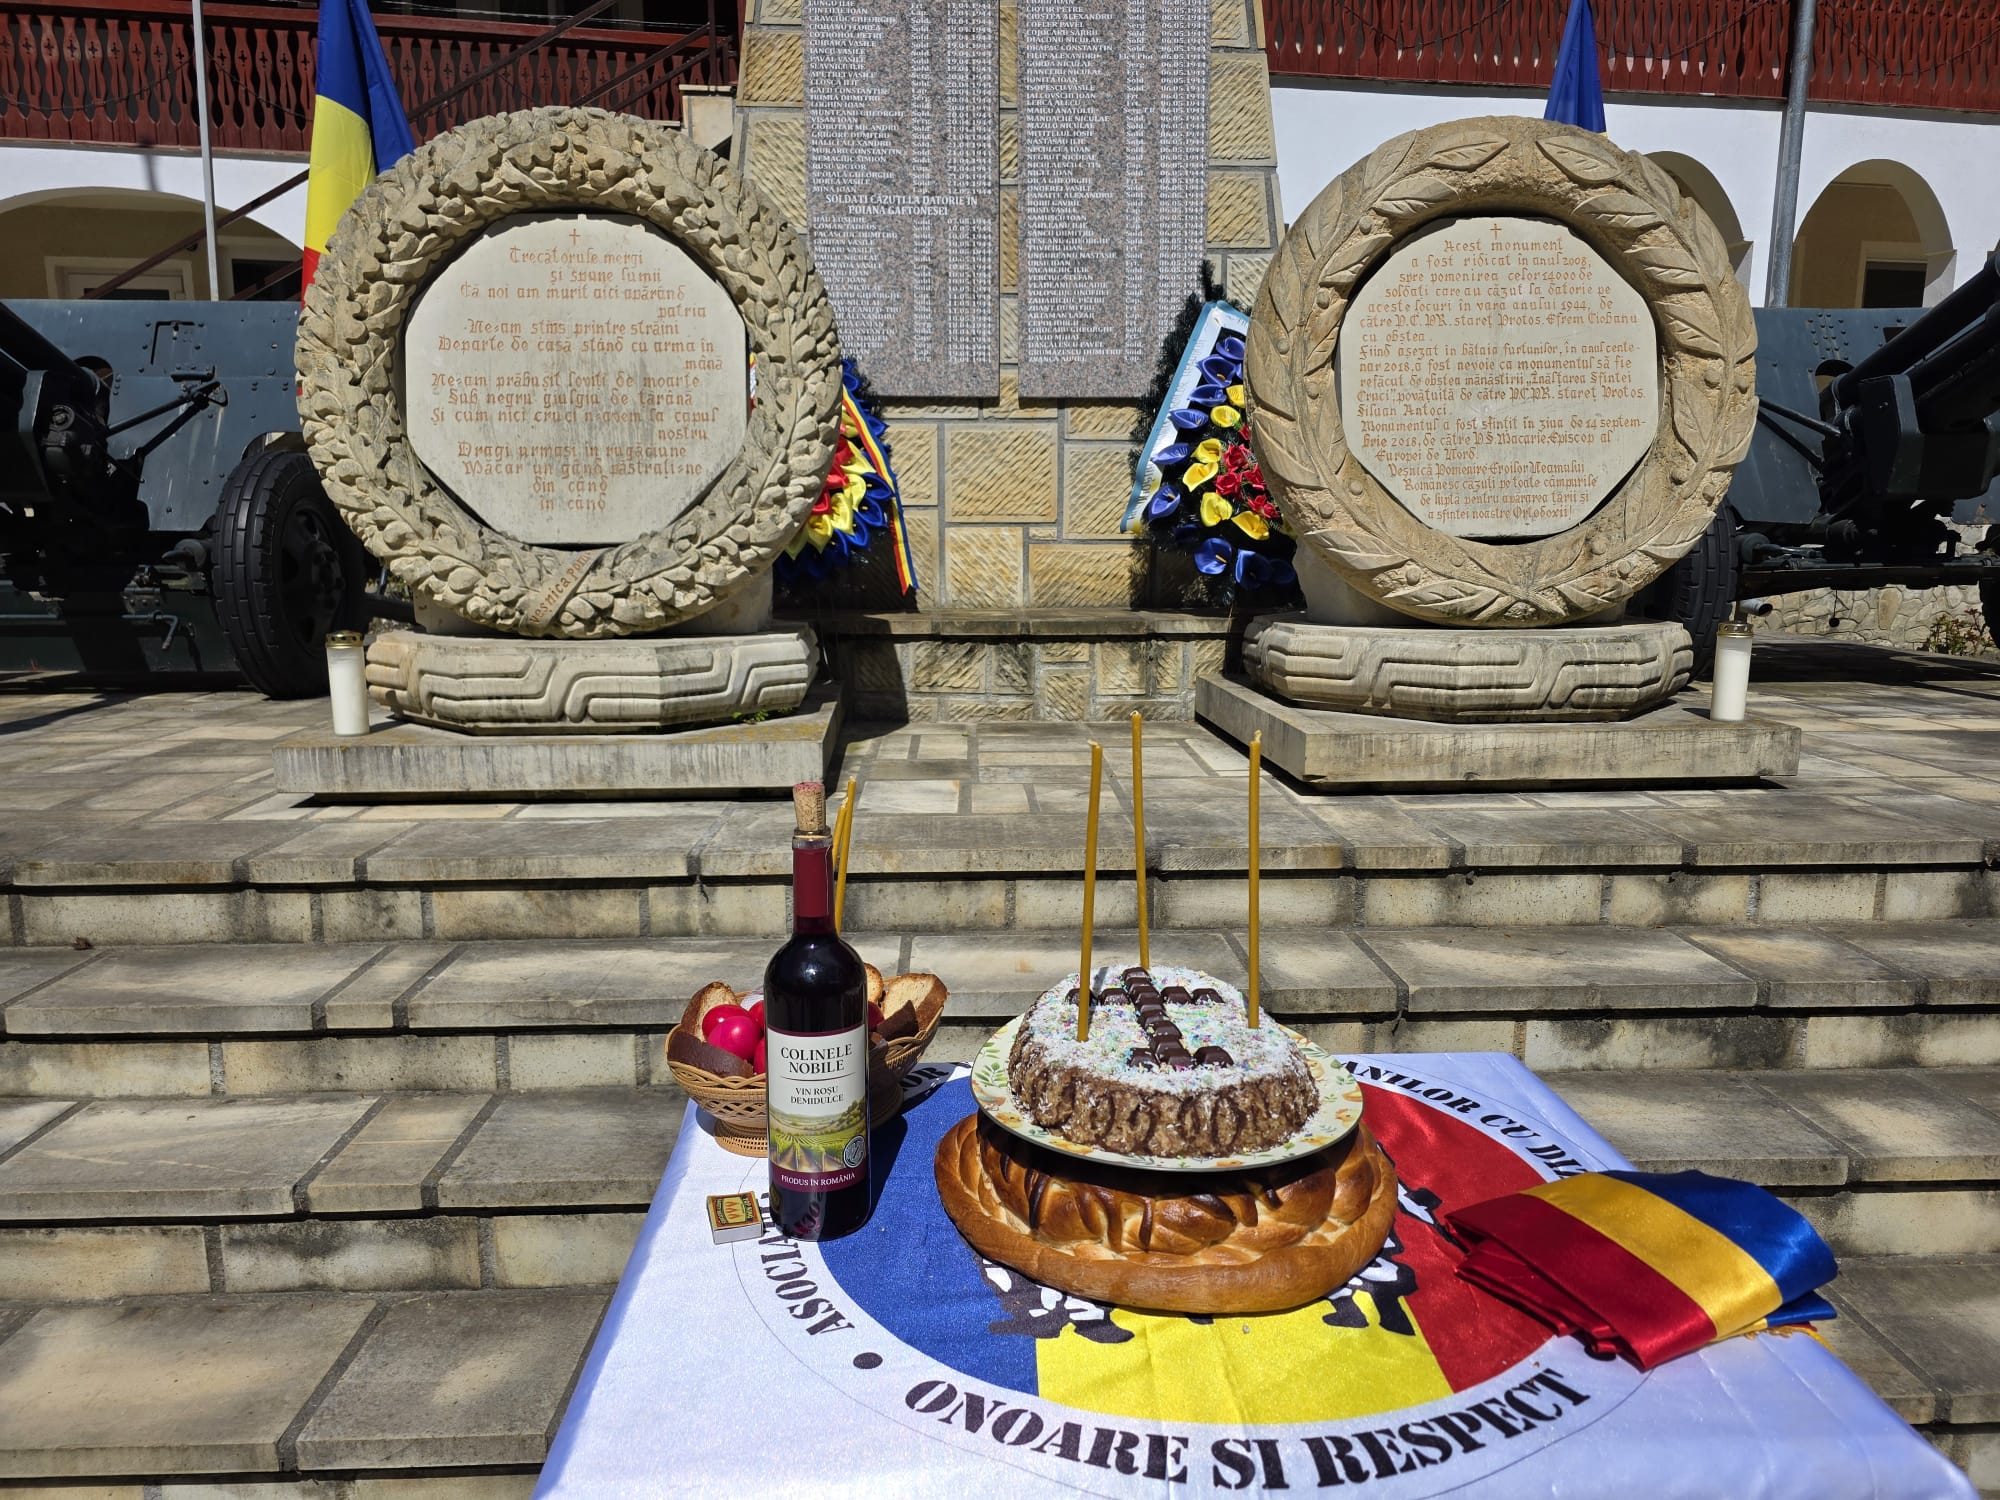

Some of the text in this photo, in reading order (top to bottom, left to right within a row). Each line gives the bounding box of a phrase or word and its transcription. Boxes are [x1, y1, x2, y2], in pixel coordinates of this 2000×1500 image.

[848, 205, 886, 215] POIANA
[1444, 238, 1563, 252] Acest monument
[1411, 258, 1419, 268] a
[1426, 254, 1454, 271] fost
[1579, 267, 1593, 281] de
[488, 284, 509, 298] noi
[516, 286, 540, 298] am
[546, 285, 589, 299] murit
[593, 285, 619, 299] aici
[1435, 286, 1460, 297] care
[1464, 286, 1480, 297] au
[1529, 282, 1542, 295] la
[1548, 282, 1593, 295] datorie
[1598, 286, 1611, 297] pe
[656, 303, 706, 319] patria
[1368, 300, 1410, 313] aceste
[1600, 296, 1614, 310] de
[574, 318, 625, 336] printre
[511, 335, 529, 352] de
[631, 341, 648, 352] cu
[653, 341, 695, 352] arma
[1362, 333, 1376, 342] cu
[1428, 358, 1451, 374] fost
[616, 370, 701, 388] de moarte
[611, 388, 629, 405] de
[455, 409, 489, 423] cum
[498, 408, 527, 423] nici
[658, 426, 708, 440] nostru
[532, 462, 554, 475] un
[532, 475, 555, 493] din
[780, 1043, 853, 1061] COLINELE
[789, 1059, 844, 1074] NOBILE
[795, 1087, 812, 1096] VIN
[790, 1094, 844, 1105] DEMIDULCE
[781, 1174, 809, 1186] PRODUS
[757, 1215, 856, 1336] ASOCIA
[1340, 1060, 1481, 1114] ANILOR
[1480, 1113, 1541, 1139] CU
[905, 1367, 1591, 1490] ONOARE SI RESPECT
